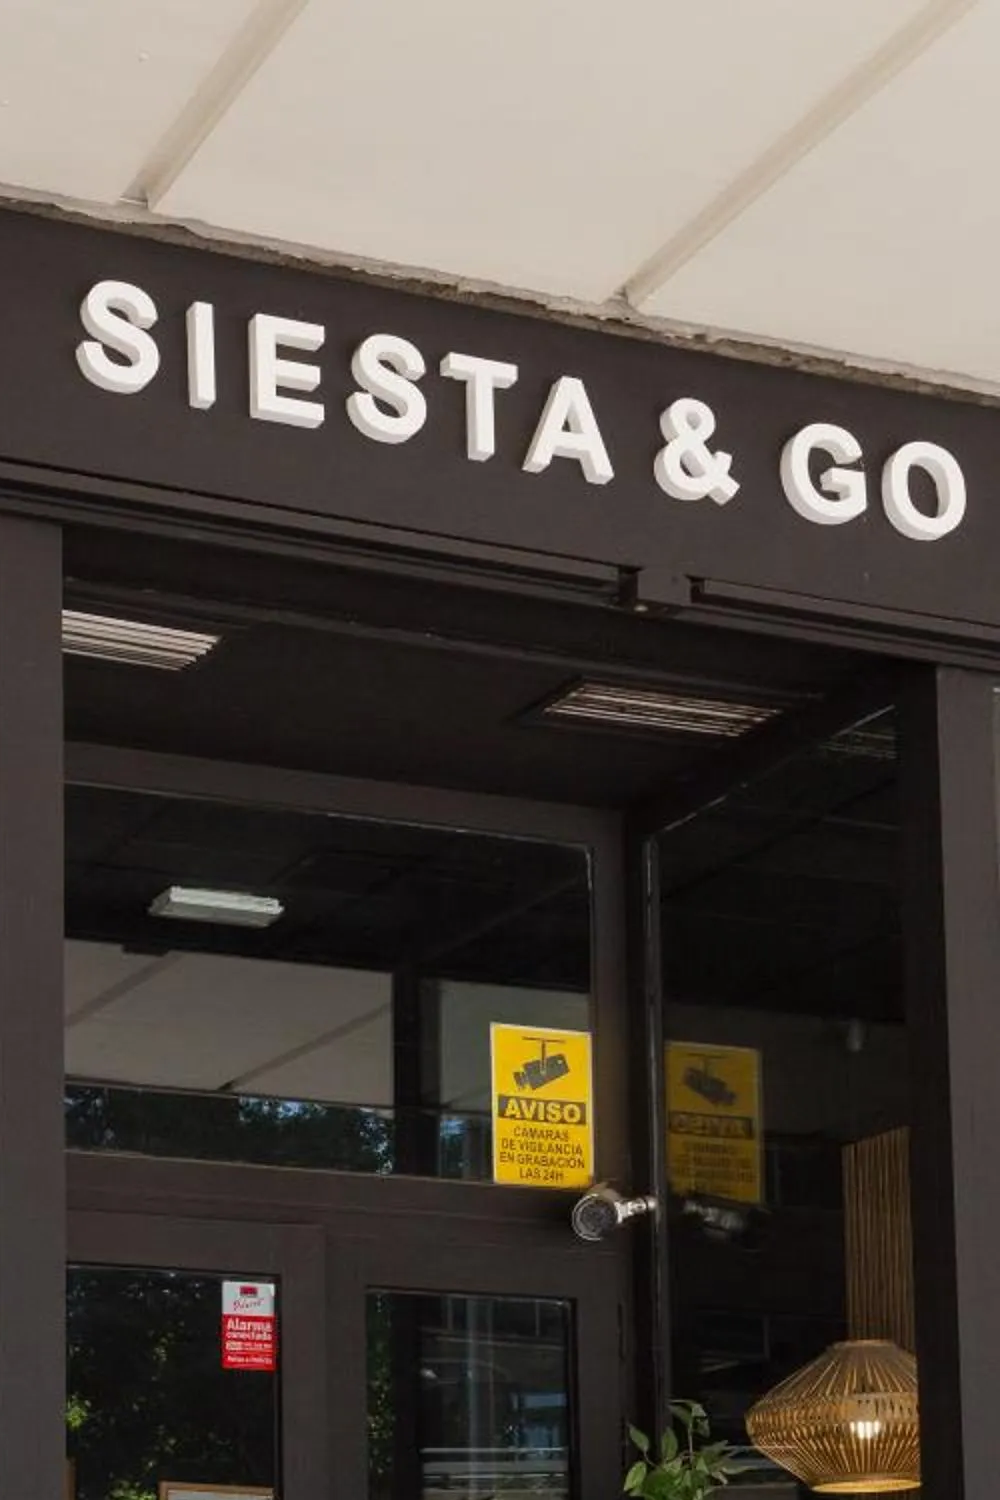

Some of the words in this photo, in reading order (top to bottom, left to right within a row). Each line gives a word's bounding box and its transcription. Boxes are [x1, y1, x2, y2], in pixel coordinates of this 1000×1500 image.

[76, 280, 615, 487] SIESTA
[653, 397, 740, 506] &
[780, 423, 967, 541] GO
[504, 1097, 581, 1123] AVISO
[501, 1138, 516, 1150] DE
[518, 1139, 583, 1156] VIGILANCIA
[500, 1151, 514, 1163] EN
[519, 1167, 541, 1179] LAS
[227, 1318, 273, 1332] Alarma
